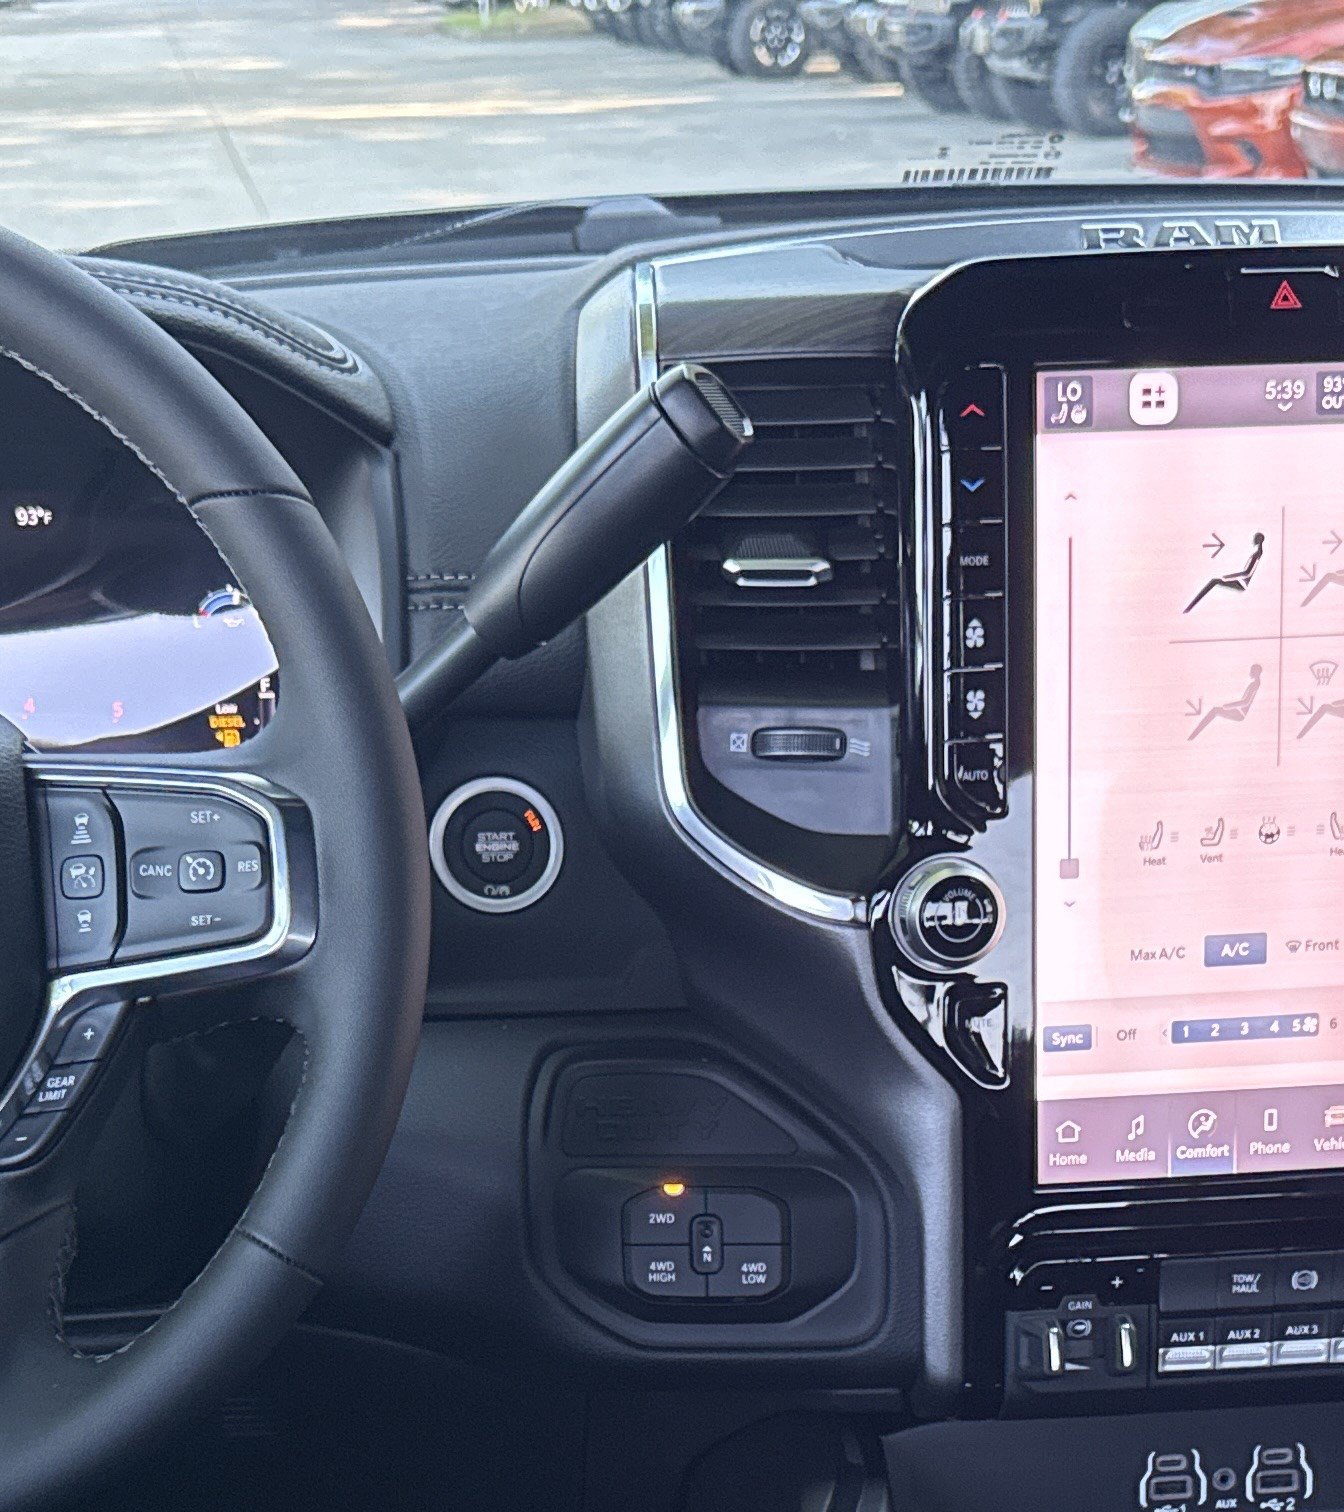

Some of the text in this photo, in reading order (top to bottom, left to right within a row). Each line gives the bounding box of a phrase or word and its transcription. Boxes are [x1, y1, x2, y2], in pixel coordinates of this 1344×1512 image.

[1081, 219, 1281, 249] RAM
[1057, 381, 1082, 401] LO
[1264, 379, 1305, 400] 5:39
[15, 505, 53, 526] 93°F
[960, 556, 989, 567] MODE
[260, 677, 271, 693] F
[963, 770, 989, 782] AUTO
[477, 831, 516, 841] START
[475, 841, 520, 853] ENGINE
[482, 853, 514, 863] STOP
[1143, 856, 1167, 867] Heat
[1200, 853, 1223, 864] Vent
[139, 864, 172, 878] CANC
[237, 860, 258, 873] RES
[942, 887, 976, 902] VOLUME
[1221, 941, 1250, 958] A/C
[1305, 940, 1339, 952] Front
[1130, 946, 1187, 962] Max A/C
[1182, 1025, 1190, 1038] 1
[1210, 1023, 1220, 1037] 2
[1240, 1021, 1250, 1035] 3
[1269, 1020, 1280, 1033] 4
[1291, 1018, 1301, 1032] 5
[1329, 1017, 1338, 1030] 6
[1052, 1031, 1084, 1048] Sync
[1116, 1028, 1138, 1042] Off
[46, 1075, 76, 1089] GEAR
[38, 1089, 67, 1102] LIMIT
[1176, 1143, 1230, 1160] Comfort
[1249, 1141, 1291, 1155] Phone
[1049, 1153, 1088, 1167] Home
[1115, 1148, 1156, 1163] Media
[649, 1213, 676, 1225] 2WD
[702, 1253, 712, 1263] N
[649, 1261, 675, 1272] 4WD
[741, 1262, 767, 1274] 4WD
[648, 1272, 676, 1283] HIGH
[741, 1274, 767, 1285] LOW
[1232, 1283, 1259, 1294] HAUL
[1067, 1300, 1093, 1311] GAIN
[1227, 1328, 1261, 1340] AUX 2
[1285, 1324, 1319, 1336] AUX 3
[1170, 1332, 1196, 1343] AUX
[1215, 1498, 1238, 1510] AUX
[1285, 1497, 1296, 1511] 2
